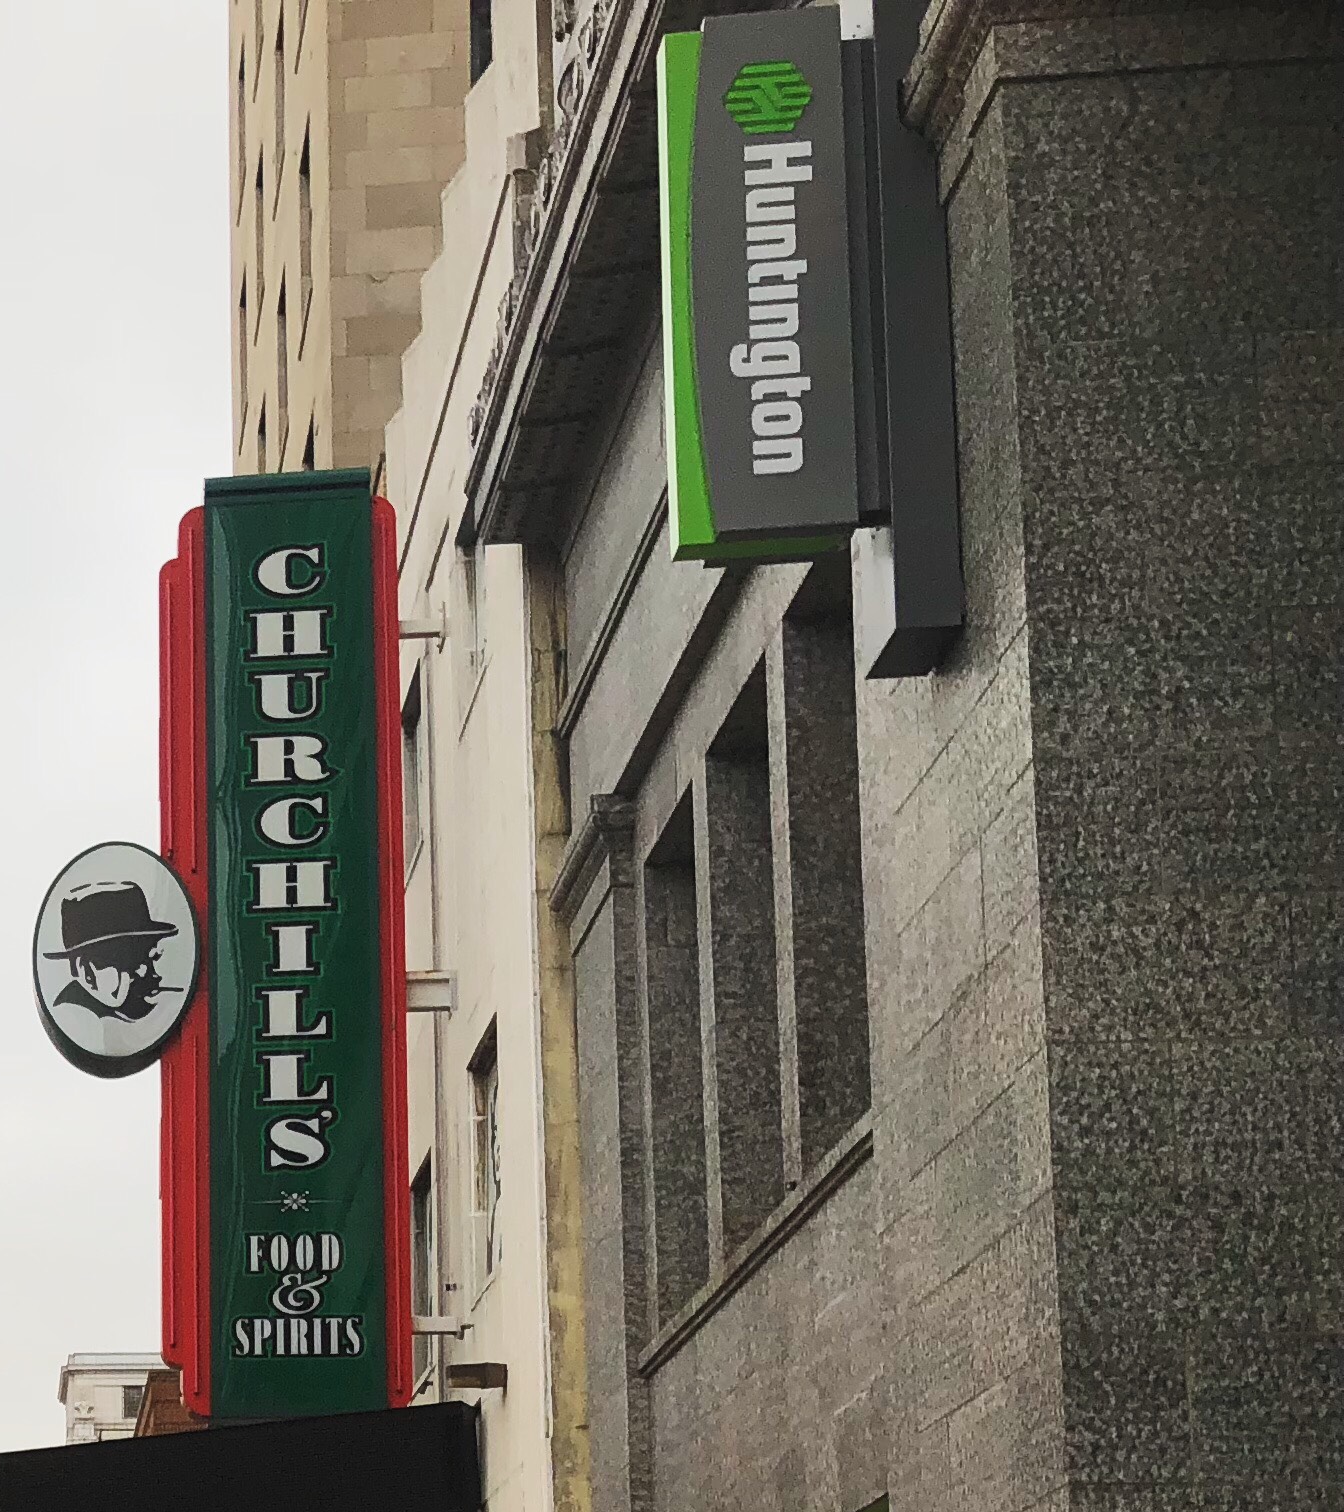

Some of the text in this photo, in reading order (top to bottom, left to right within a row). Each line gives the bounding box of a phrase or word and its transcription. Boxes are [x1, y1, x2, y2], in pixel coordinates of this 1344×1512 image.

[730, 140, 813, 476] Huntington
[248, 1235, 342, 1272] FOOD
[272, 1273, 328, 1314] &
[235, 1316, 364, 1357] SPIRITS
